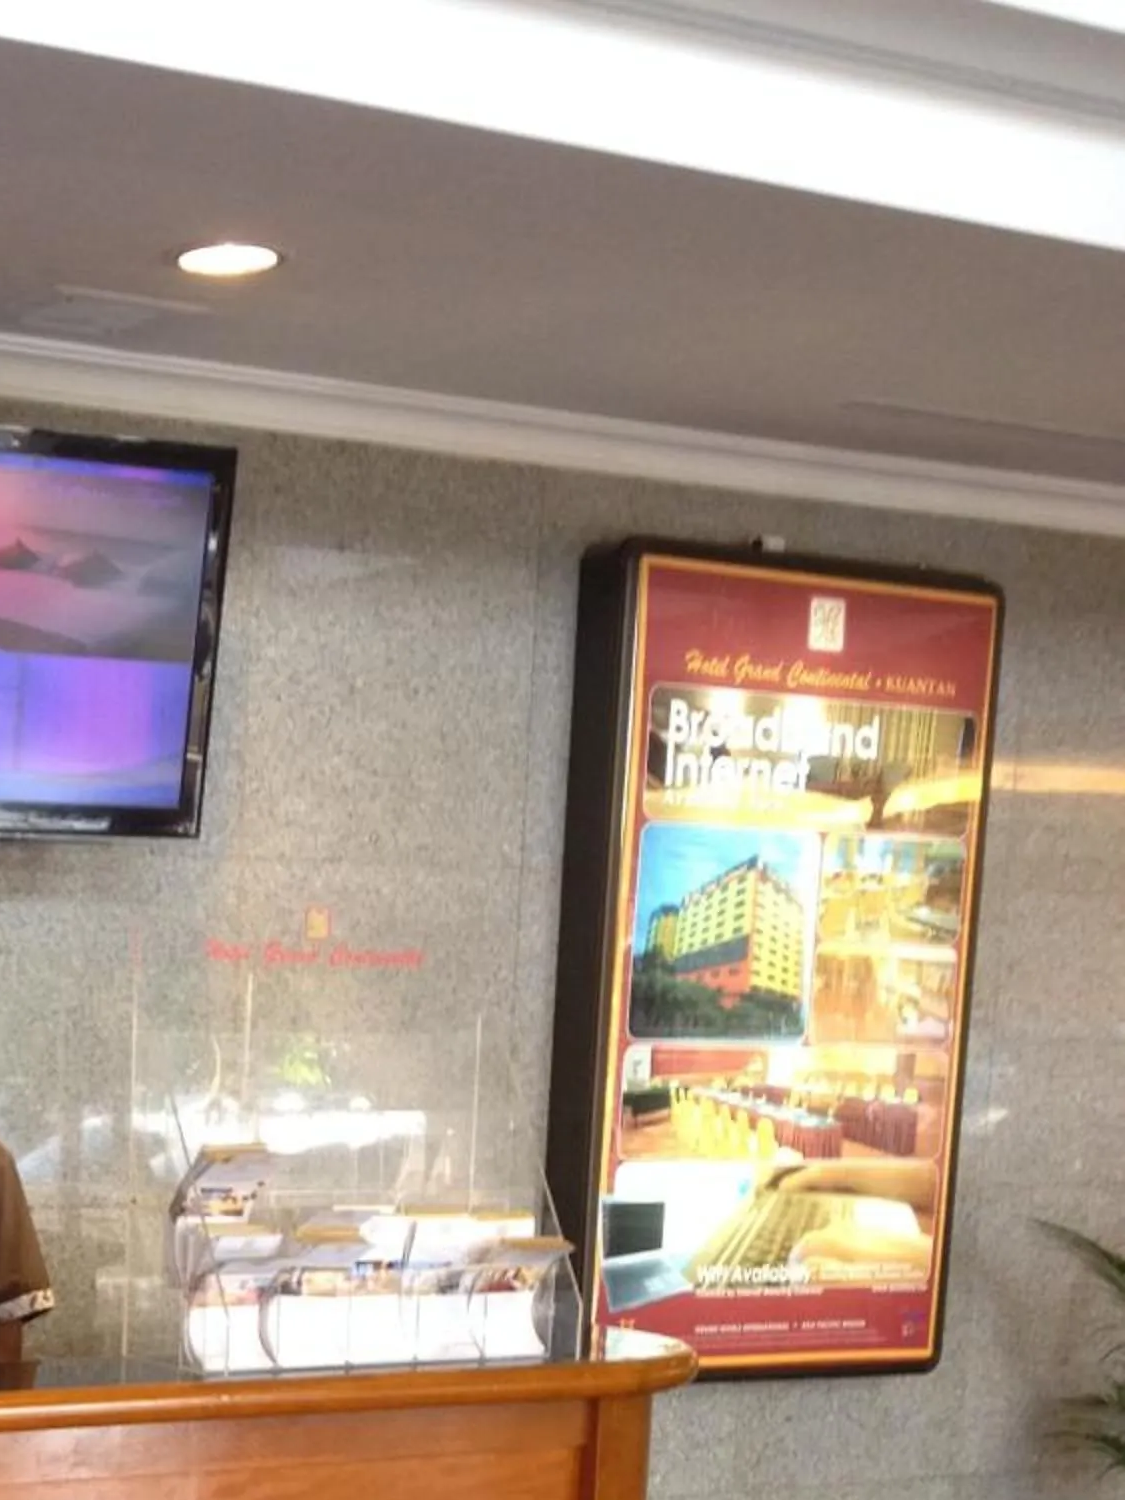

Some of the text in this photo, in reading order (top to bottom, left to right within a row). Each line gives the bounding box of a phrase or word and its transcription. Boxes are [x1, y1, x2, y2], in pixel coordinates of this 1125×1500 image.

[685, 649, 730, 677] Hotel
[734, 653, 784, 685] Grand
[786, 660, 872, 691] Continental
[667, 698, 880, 760] Broadnd
[665, 745, 810, 793] Internet
[730, 1263, 811, 1285] Availaby
